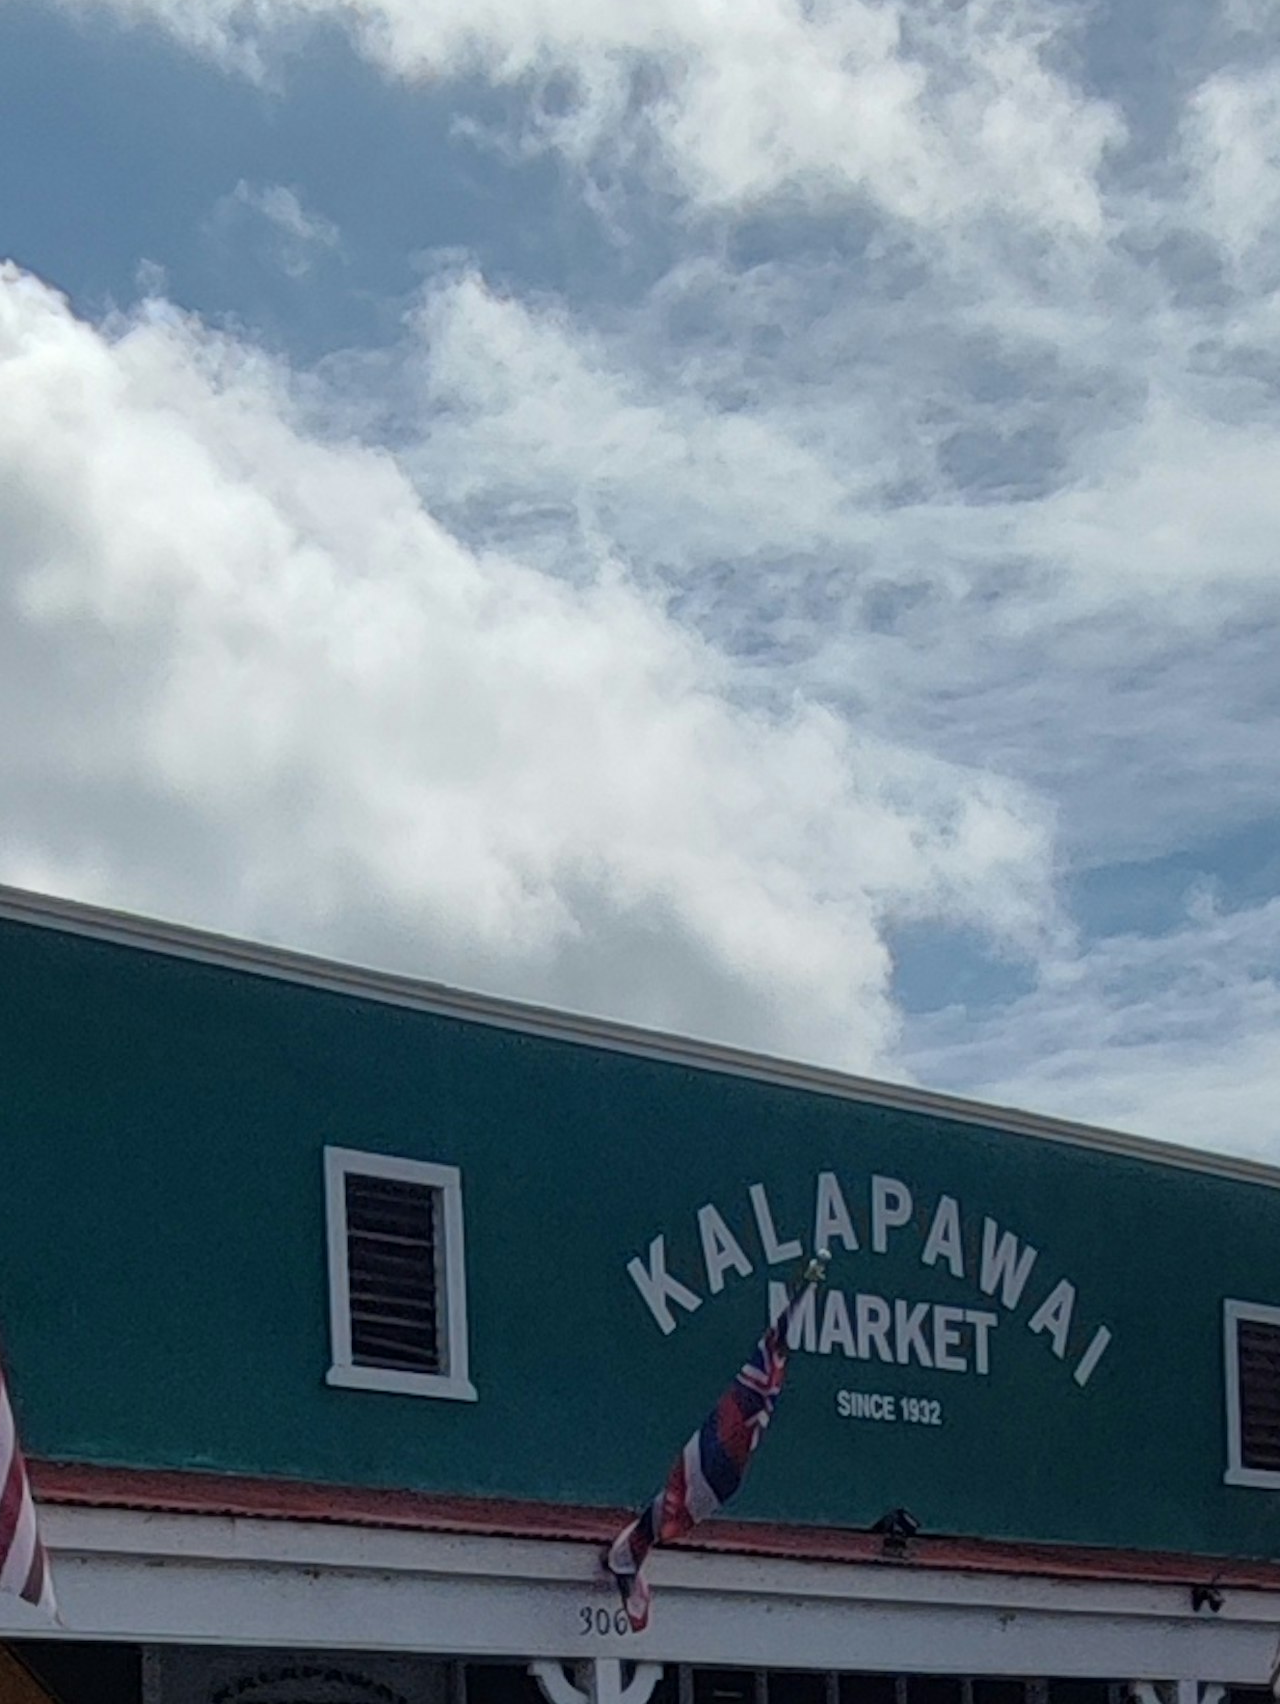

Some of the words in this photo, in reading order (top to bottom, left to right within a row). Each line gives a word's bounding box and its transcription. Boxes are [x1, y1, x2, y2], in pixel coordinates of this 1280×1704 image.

[626, 1170, 1113, 1387] KALAPAWAI
[767, 1280, 999, 1375] MARKET
[837, 1389, 896, 1421] SINCE
[899, 1396, 942, 1426] 1932
